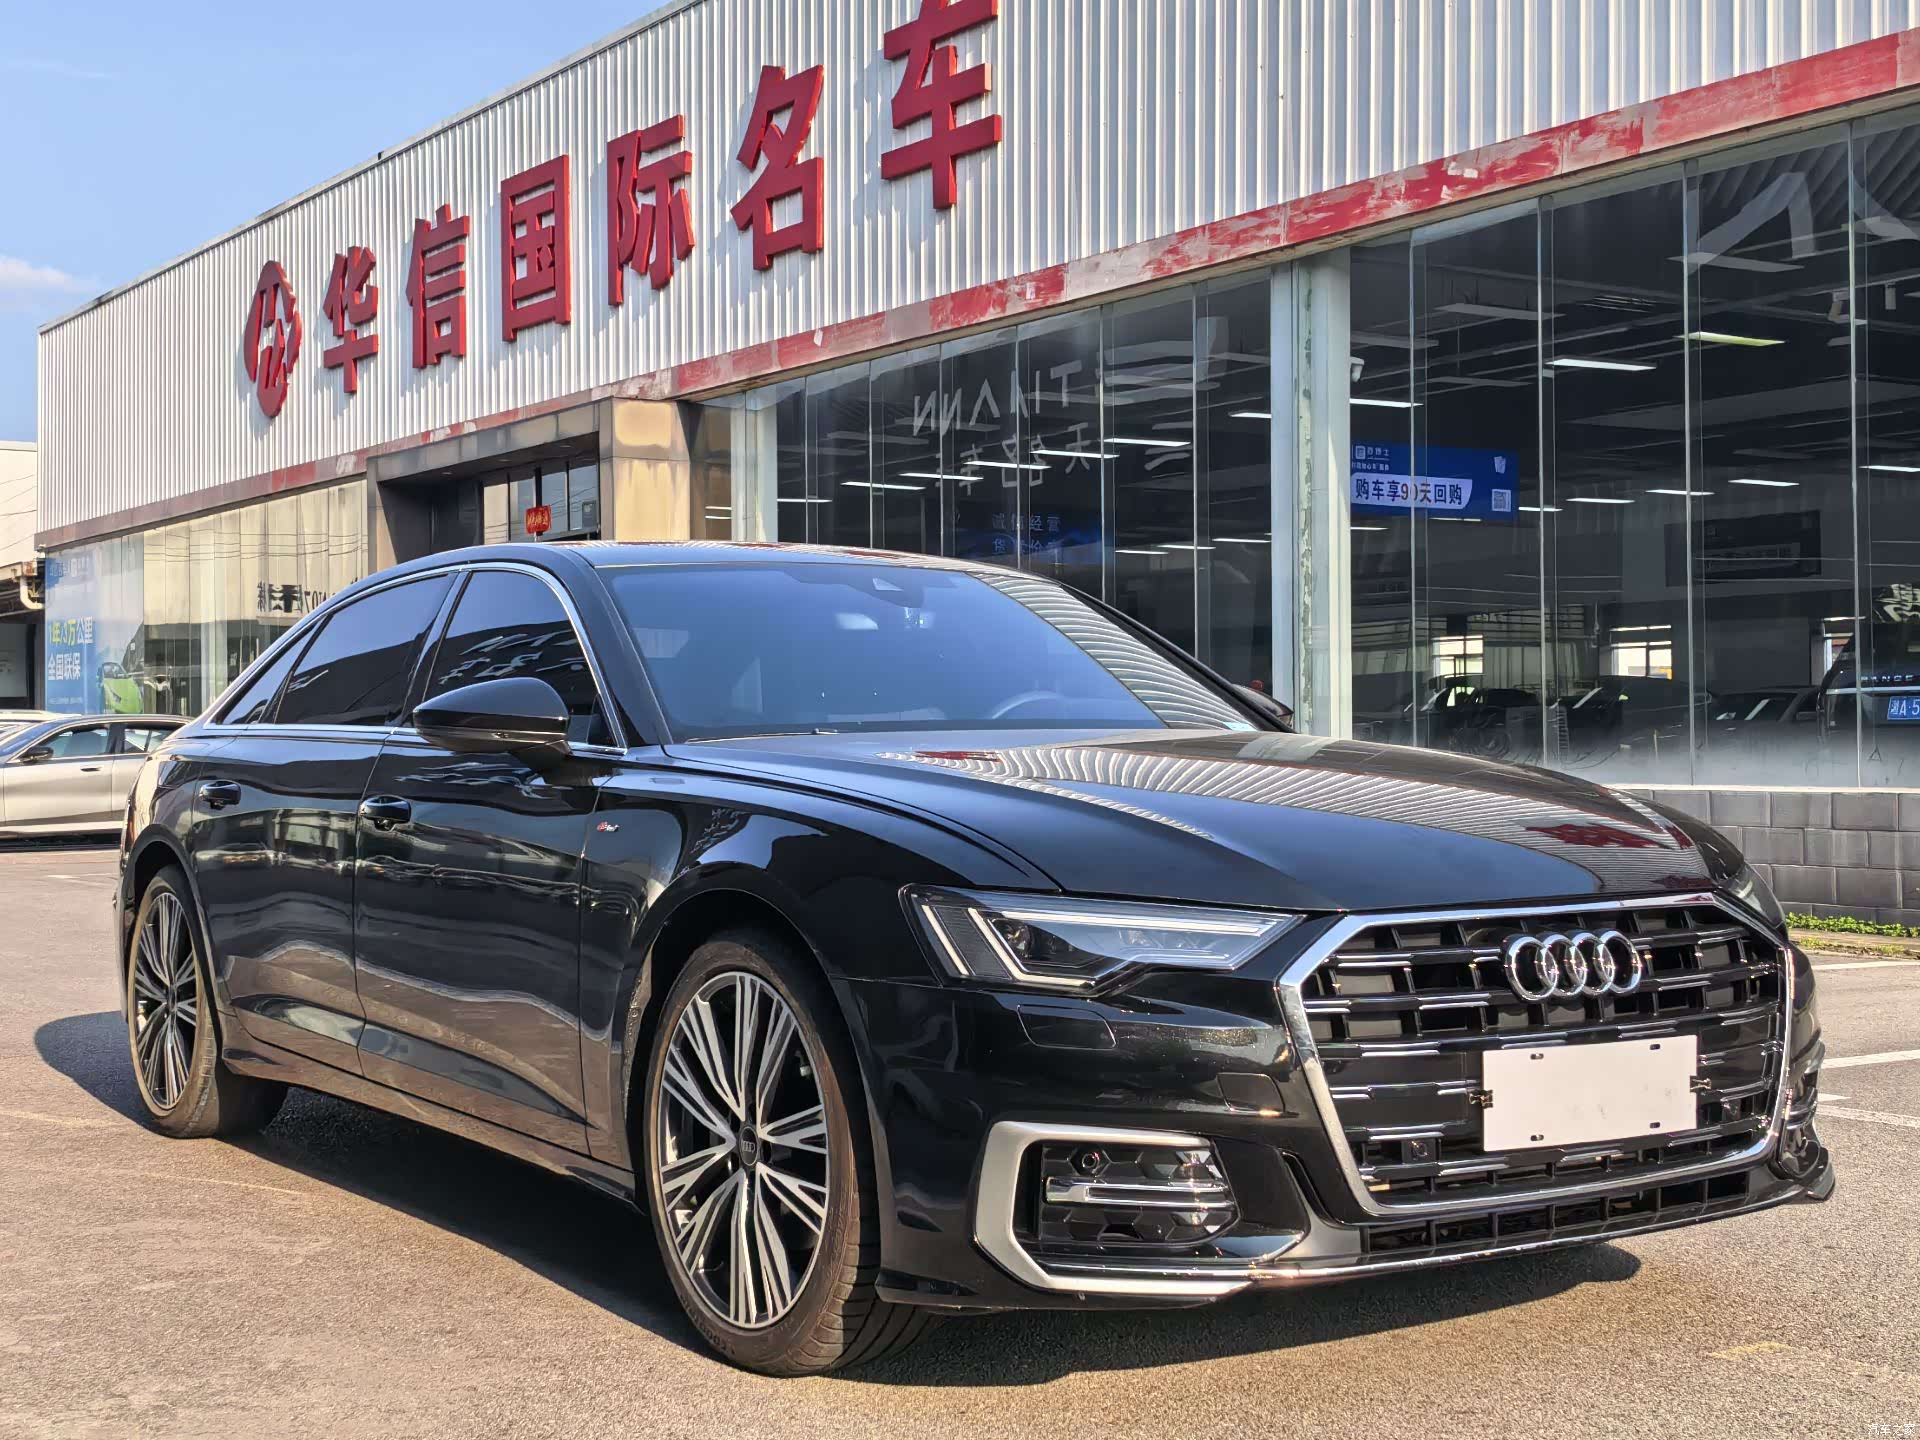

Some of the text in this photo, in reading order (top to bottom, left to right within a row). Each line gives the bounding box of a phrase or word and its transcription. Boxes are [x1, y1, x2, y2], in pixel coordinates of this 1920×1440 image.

[323, 0, 1002, 393] 华信国际名车
[48, 652, 81, 681] 全国联保
